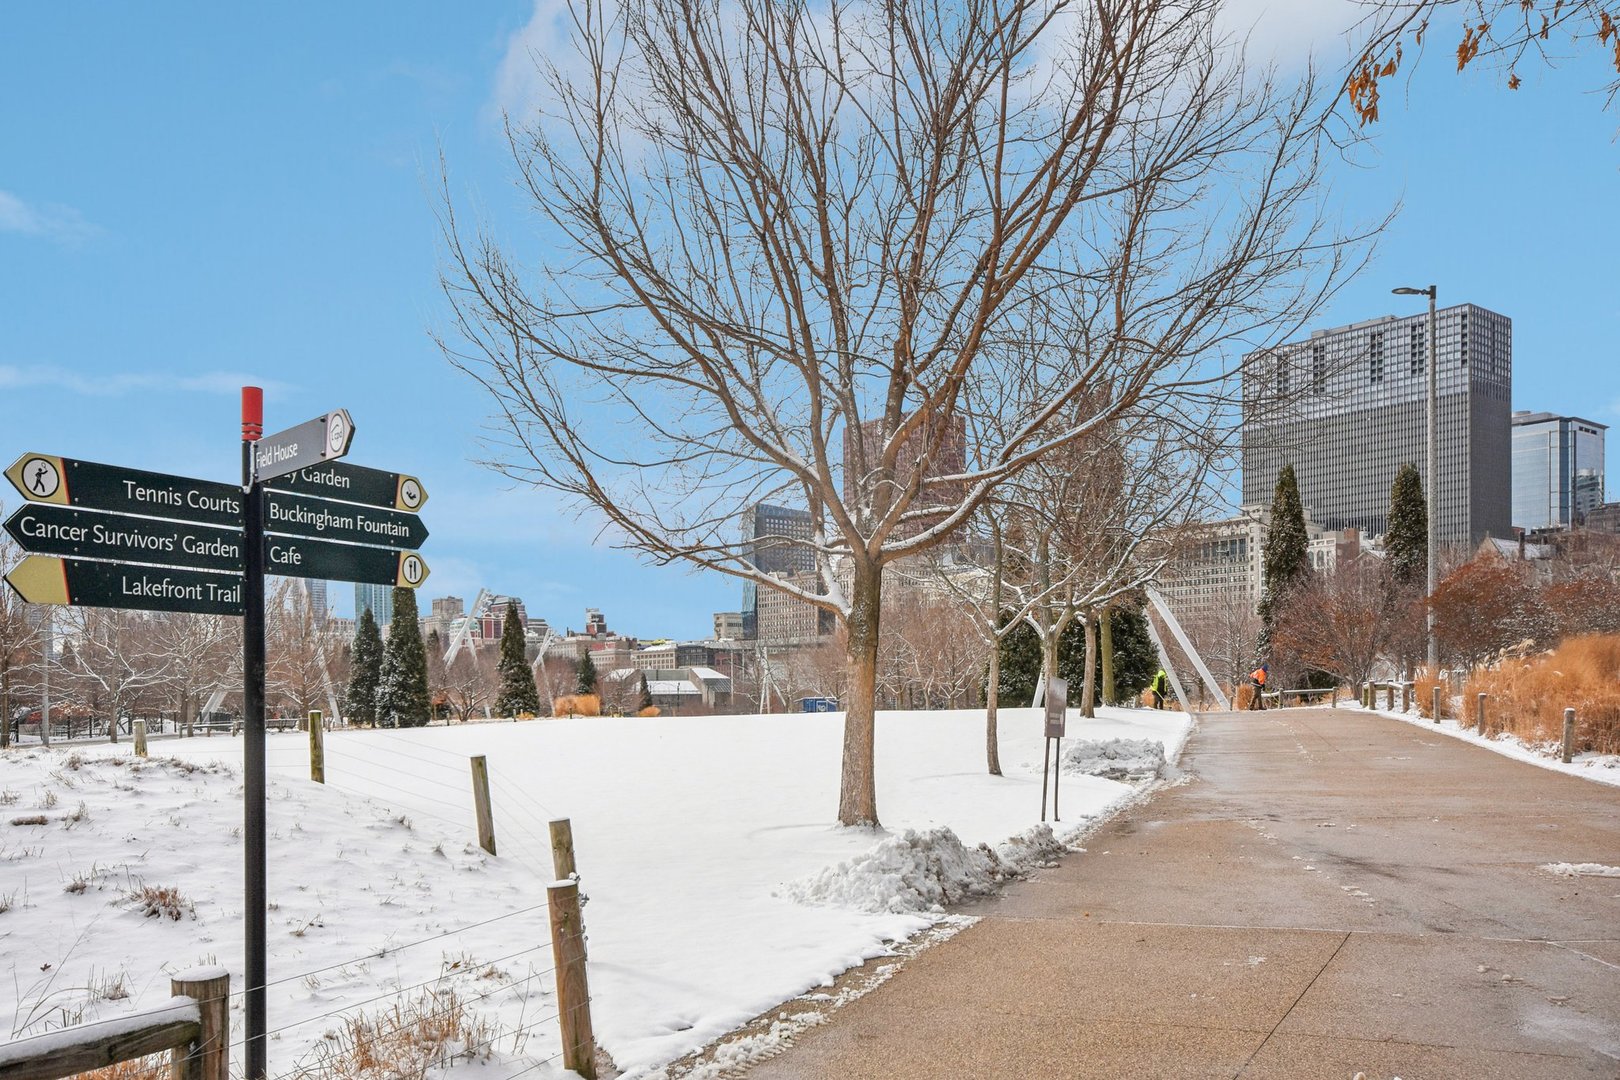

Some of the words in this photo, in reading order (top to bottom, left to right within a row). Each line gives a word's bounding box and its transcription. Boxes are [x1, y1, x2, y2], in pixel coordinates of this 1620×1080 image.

[256, 445, 272, 469] Field
[273, 443, 298, 463] House
[301, 467, 350, 489] Garden
[123, 480, 182, 506] Tennis
[187, 490, 240, 514] Courts
[270, 503, 353, 531] Buckingham
[357, 516, 409, 537] Fountain
[20, 516, 88, 542] Cancer
[182, 535, 239, 558] Garden
[270, 546, 301, 565] Cafe
[122, 576, 202, 600] Lakefront
[206, 583, 241, 603] Trail
